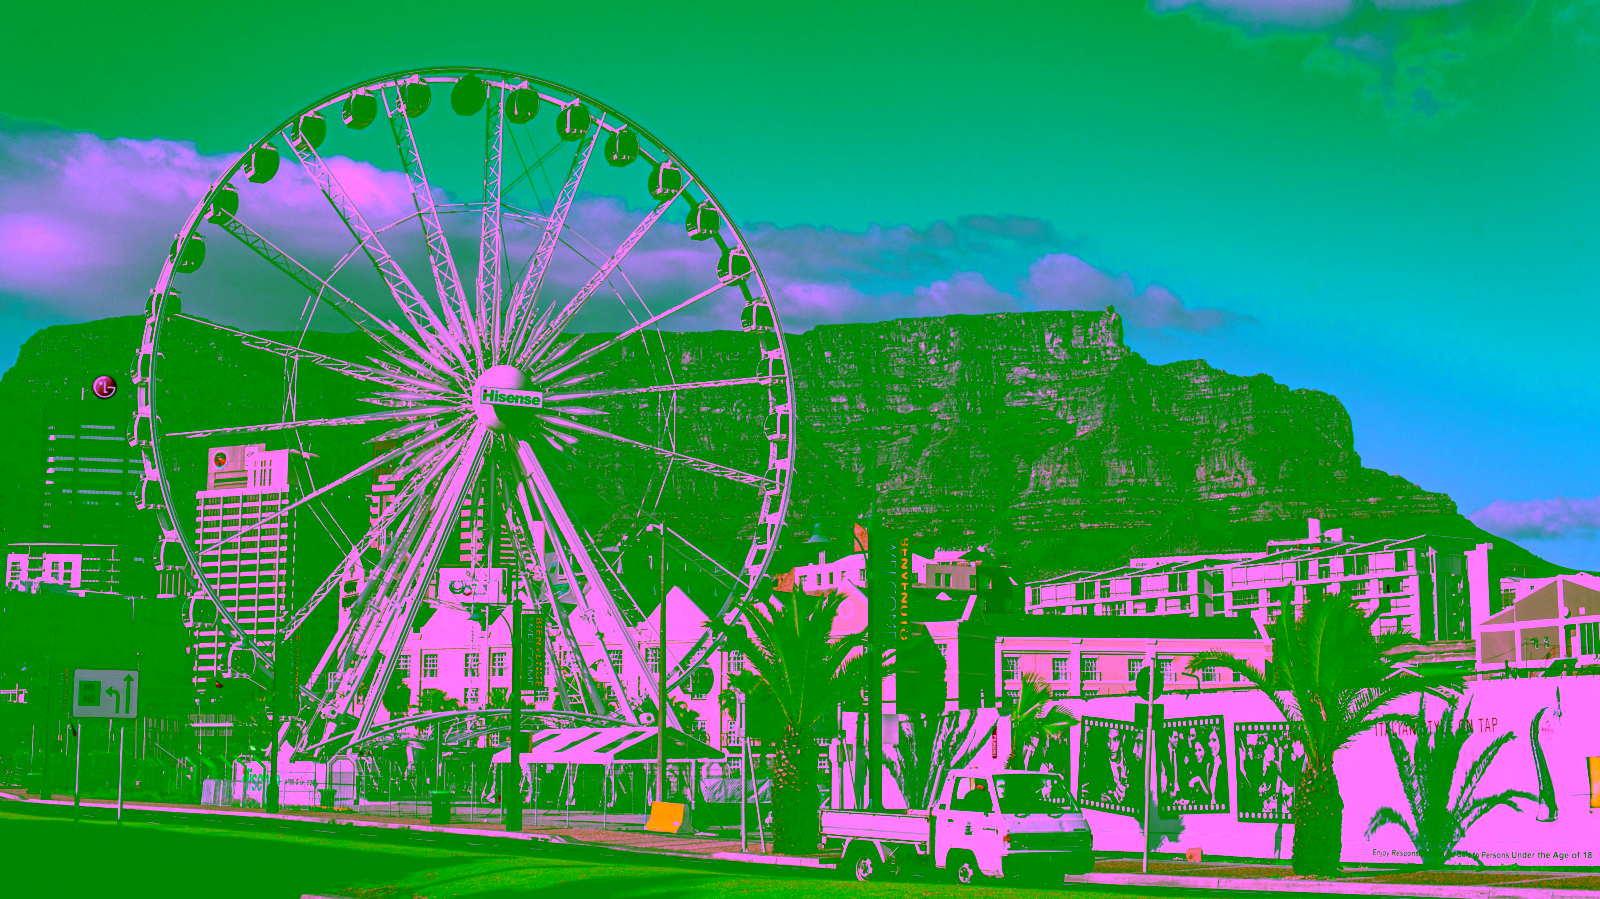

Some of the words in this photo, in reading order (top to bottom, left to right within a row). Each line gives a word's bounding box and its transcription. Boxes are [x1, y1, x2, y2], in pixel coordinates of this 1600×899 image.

[482, 389, 541, 406] Hisense
[535, 617, 543, 687] BIENVENUE
[84, 683, 94, 692] N1
[83, 694, 95, 703] N2
[1478, 717, 1498, 733] TAP
[1372, 848, 1390, 858] Enjoy
[1481, 851, 1510, 859] Persons
[1511, 851, 1535, 859] Under
[1537, 851, 1551, 859] the
[1552, 851, 1569, 861] Age
[1571, 851, 1581, 859] of
[1583, 851, 1595, 859] 18.
